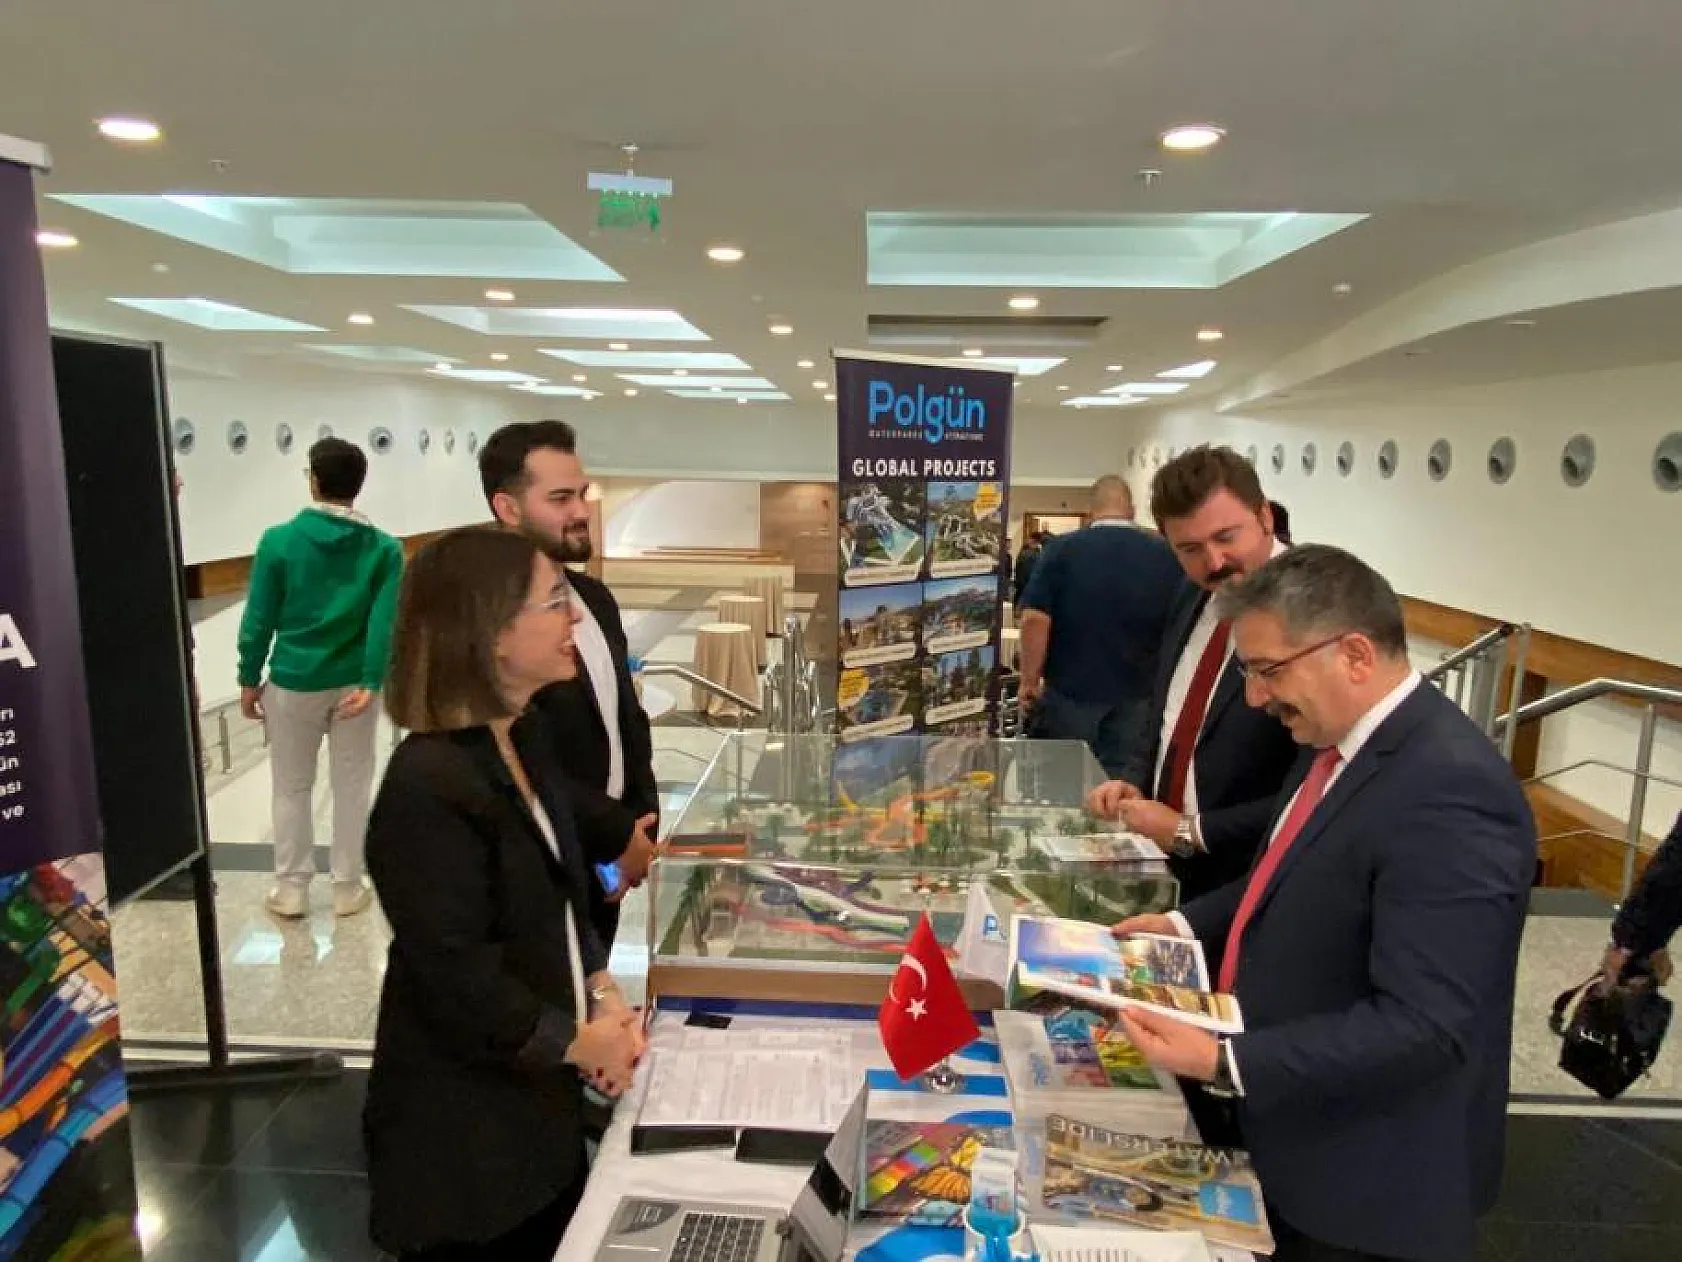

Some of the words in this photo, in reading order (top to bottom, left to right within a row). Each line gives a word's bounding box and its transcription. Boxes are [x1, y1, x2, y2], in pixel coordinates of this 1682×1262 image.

[868, 380, 986, 443] Polgün
[852, 457, 919, 477] GLOBAL
[923, 458, 997, 478] PROJECTS
